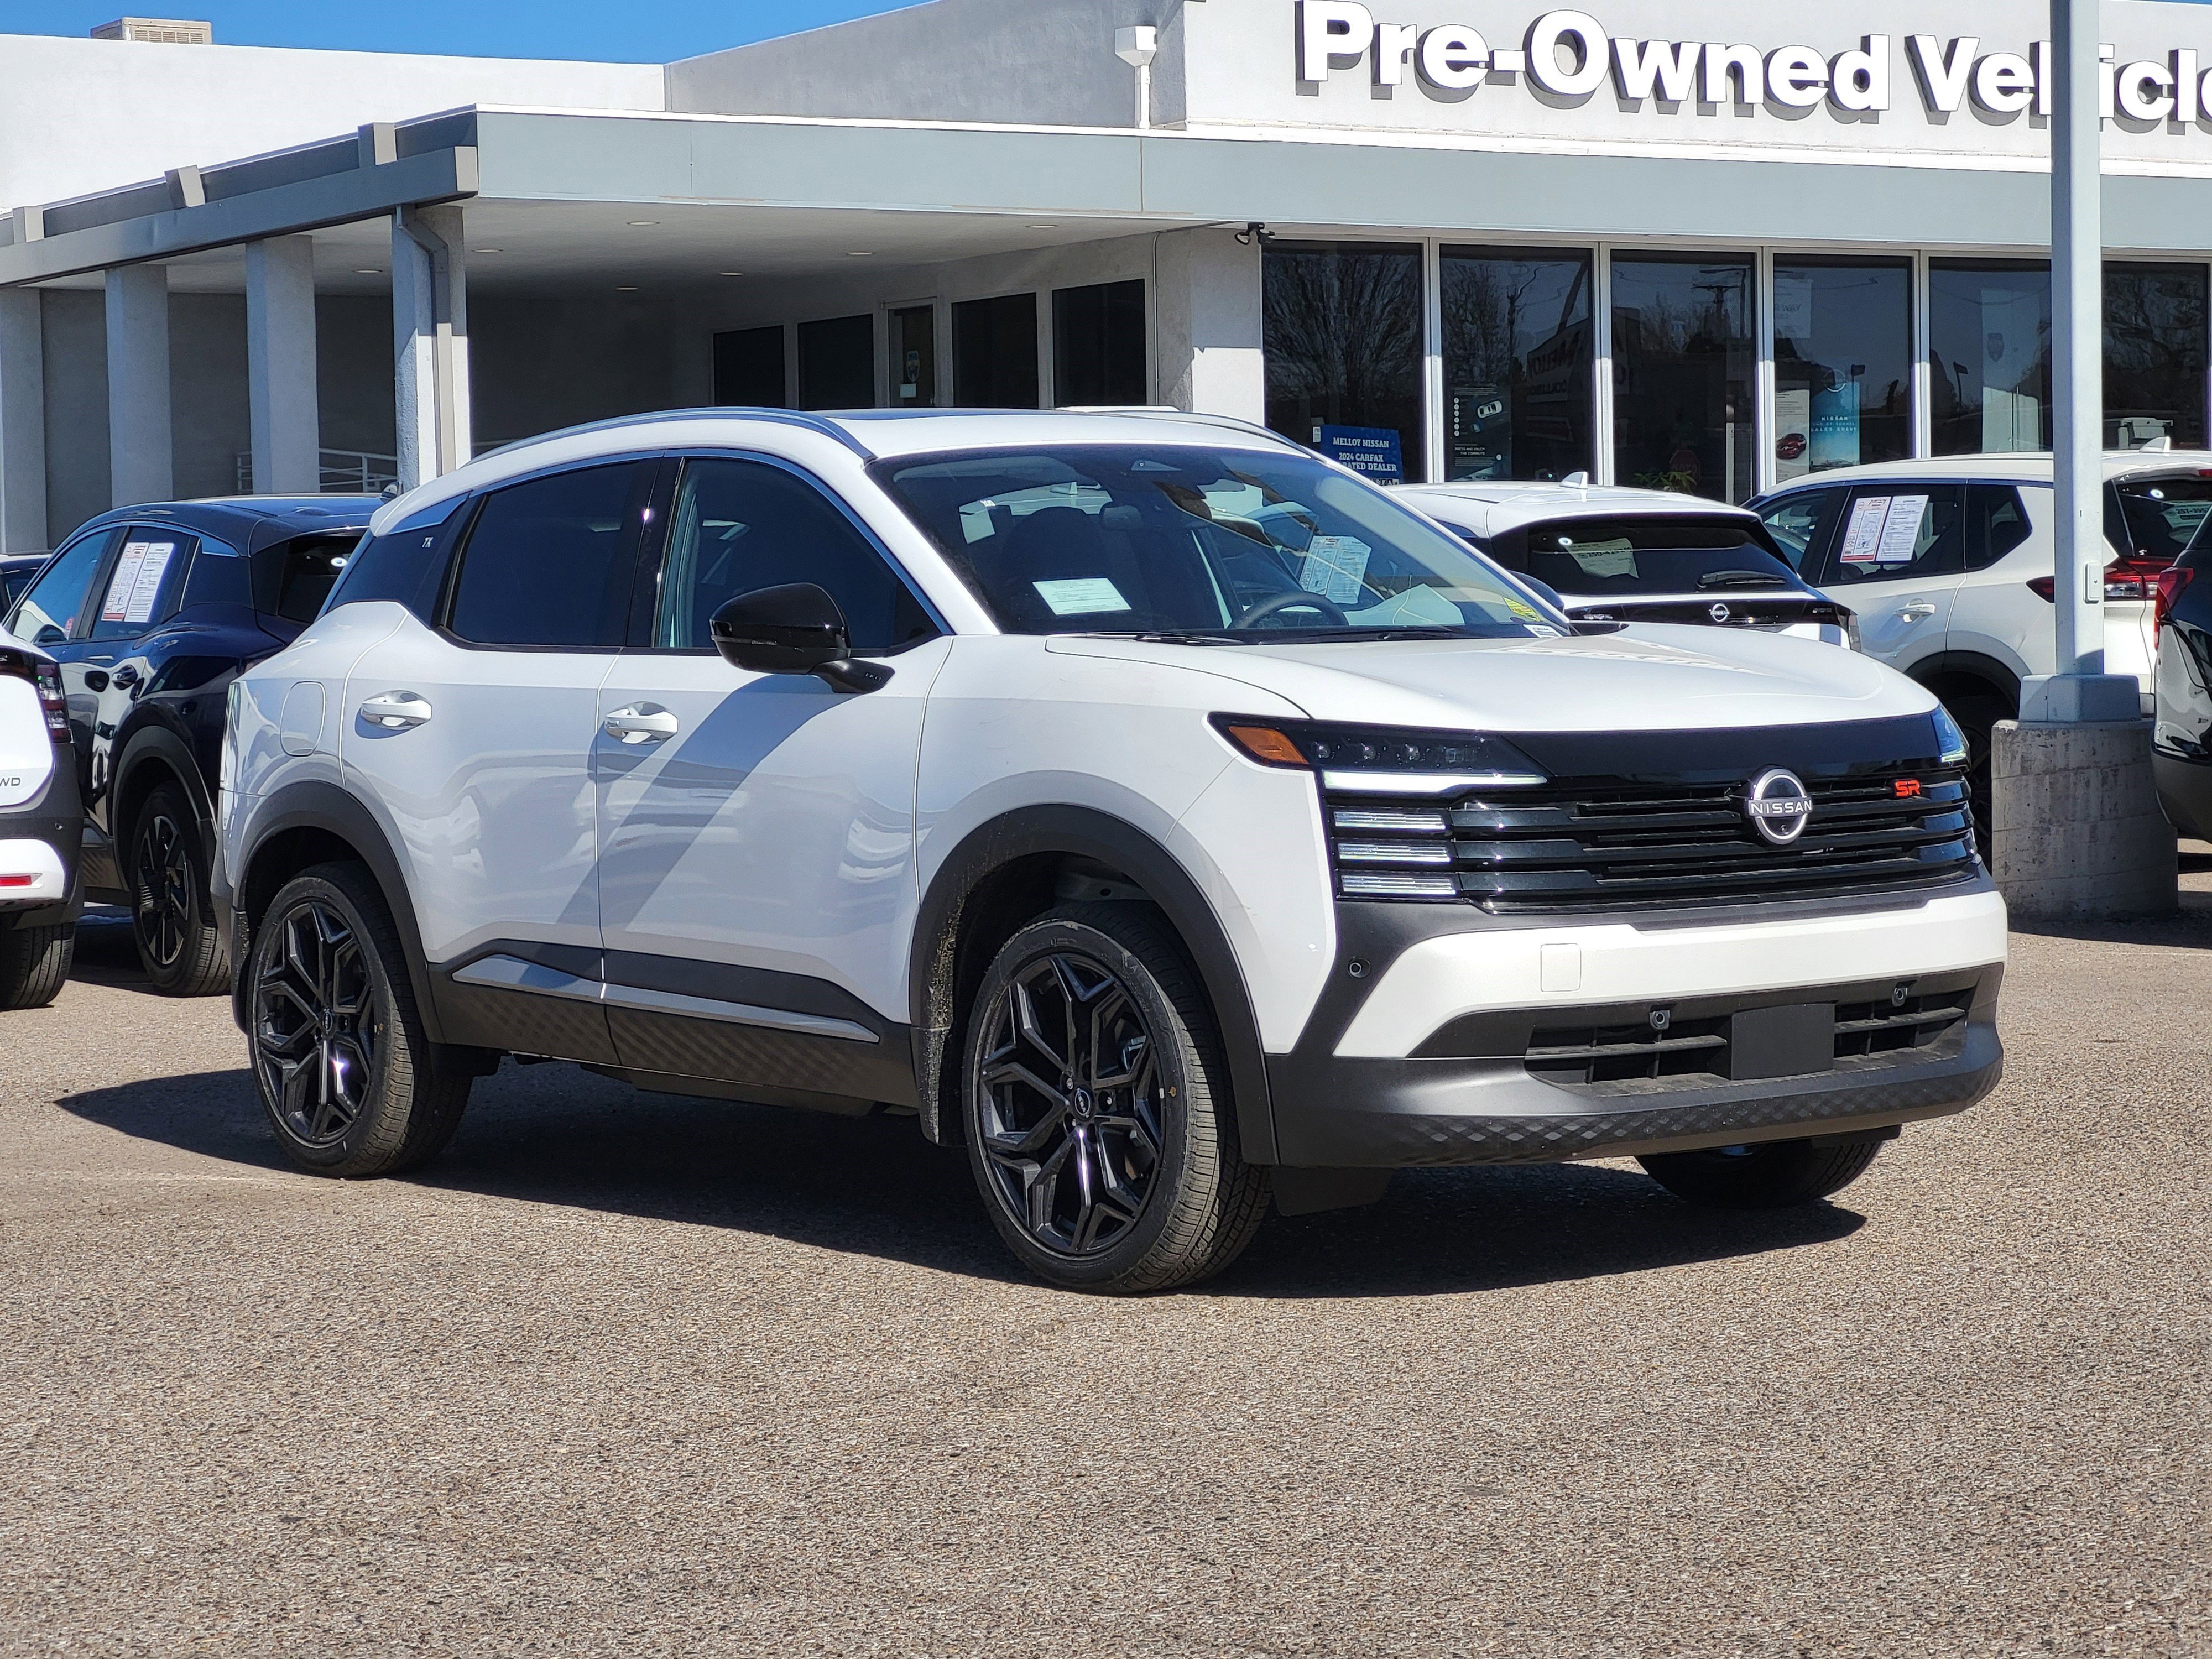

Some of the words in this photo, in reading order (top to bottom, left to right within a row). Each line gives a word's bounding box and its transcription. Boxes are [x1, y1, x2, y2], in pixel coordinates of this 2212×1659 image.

[1296, 0, 1890, 113] Pre-Owned
[1906, 33, 2212, 123] Veicl
[1333, 437, 1361, 446] MELLOY
[1363, 440, 1389, 448] NISSAN
[1355, 453, 1384, 462] CARFAX
[1368, 463, 1397, 471] DEALER
[1895, 780, 1921, 796] SR
[1750, 800, 1813, 814] NISSAN
